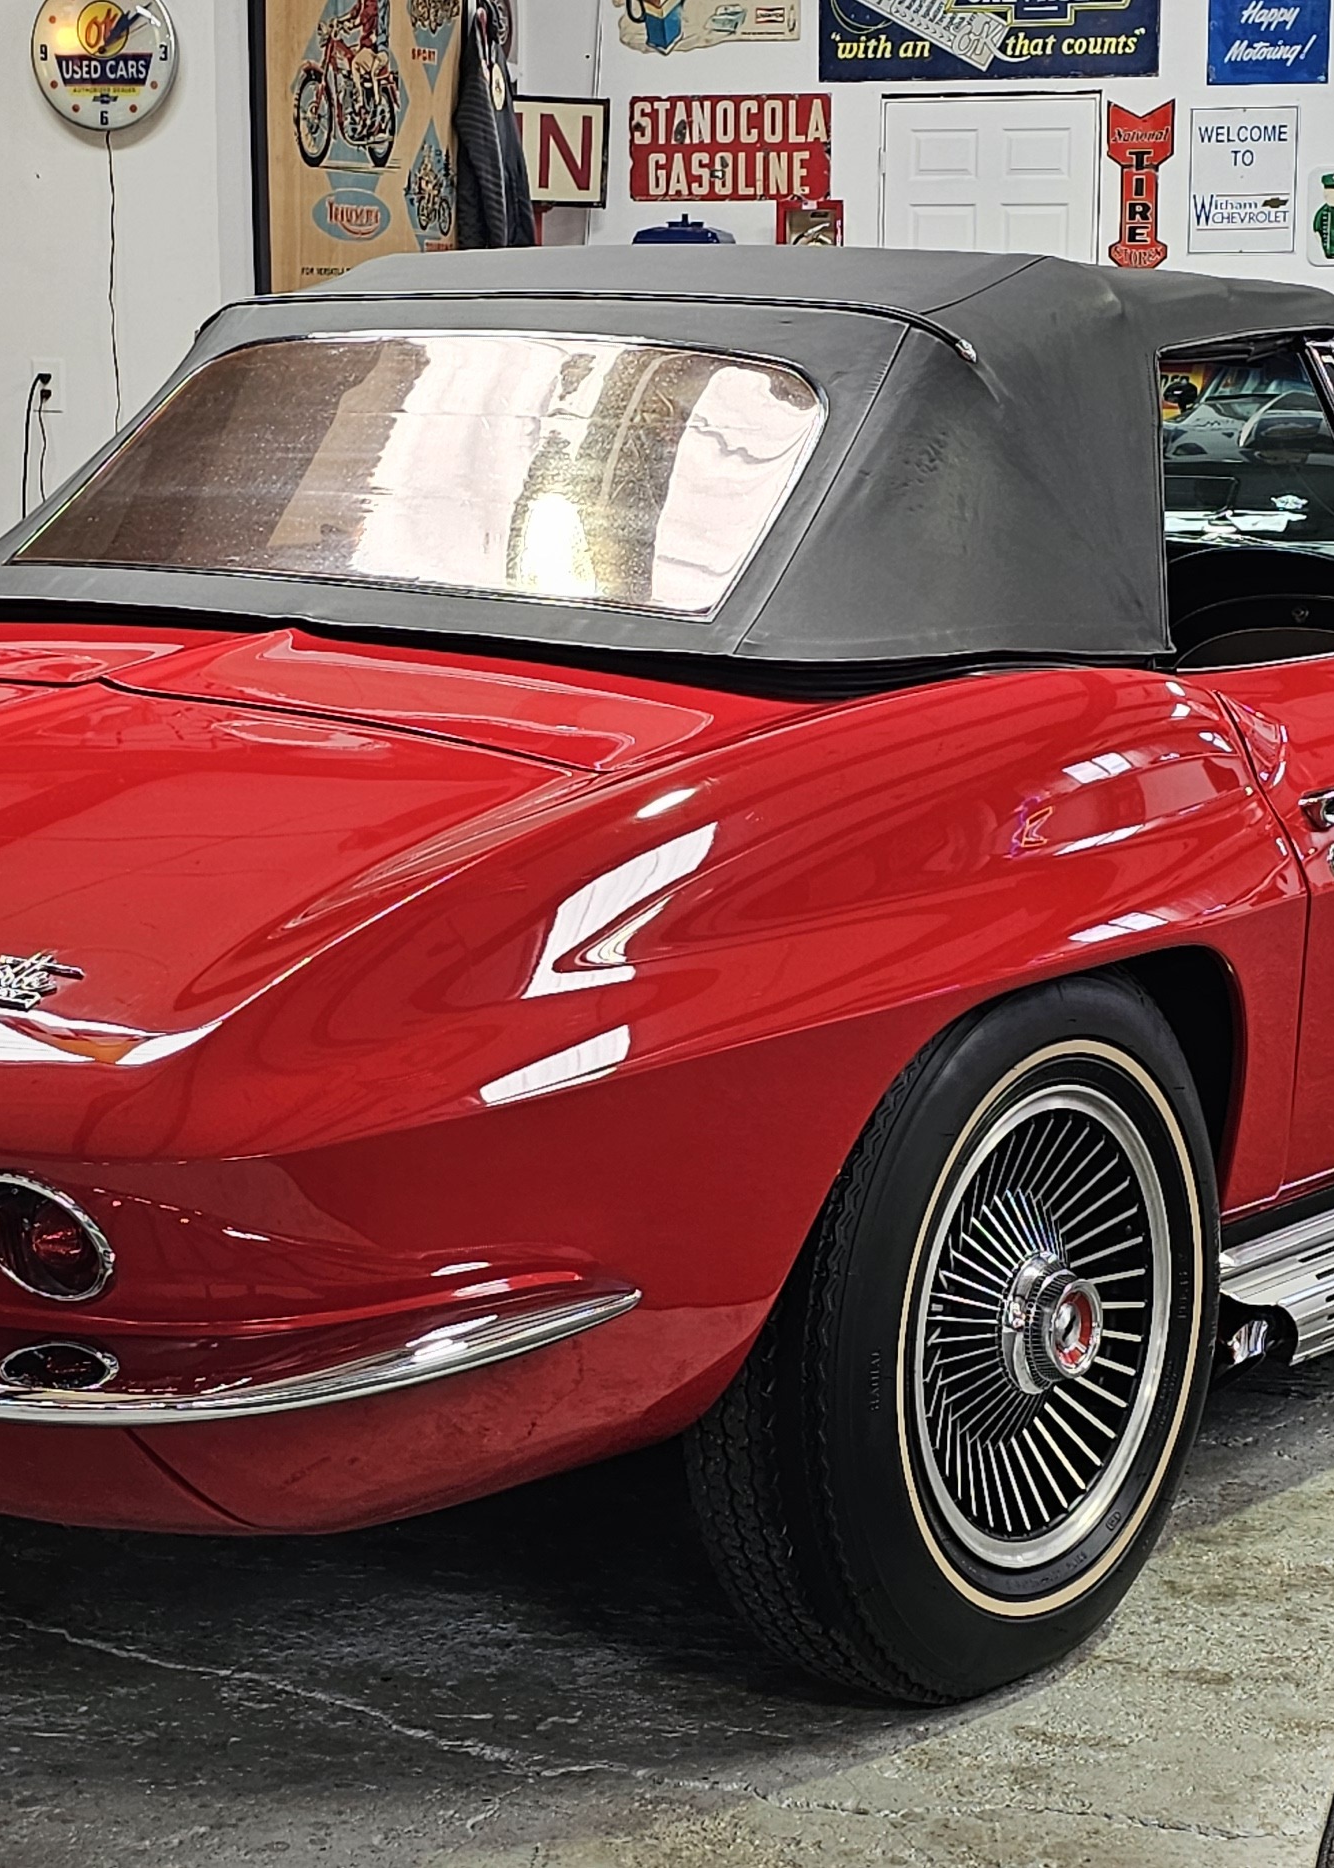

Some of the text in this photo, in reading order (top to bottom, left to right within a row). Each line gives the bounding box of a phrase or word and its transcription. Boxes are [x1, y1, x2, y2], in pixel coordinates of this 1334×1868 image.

[1240, 1, 1300, 31] Happy
[40, 44, 47, 61] 9
[159, 44, 168, 61] 3
[899, 40, 930, 58] an
[1005, 32, 1055, 56] that
[1224, 34, 1317, 66] Motoring!
[412, 49, 436, 62] SPORT
[62, 60, 146, 79] USED CARS
[100, 111, 109, 125] 6
[633, 99, 828, 144] STANOCOLA
[1112, 126, 1171, 143] National
[1198, 125, 1288, 143] WELCOME
[516, 113, 593, 191] N
[1231, 149, 1254, 167] TO
[649, 151, 810, 195] GASOLINE
[1126, 149, 1154, 244] TIRE
[1212, 210, 1289, 225] CHEVROLET
